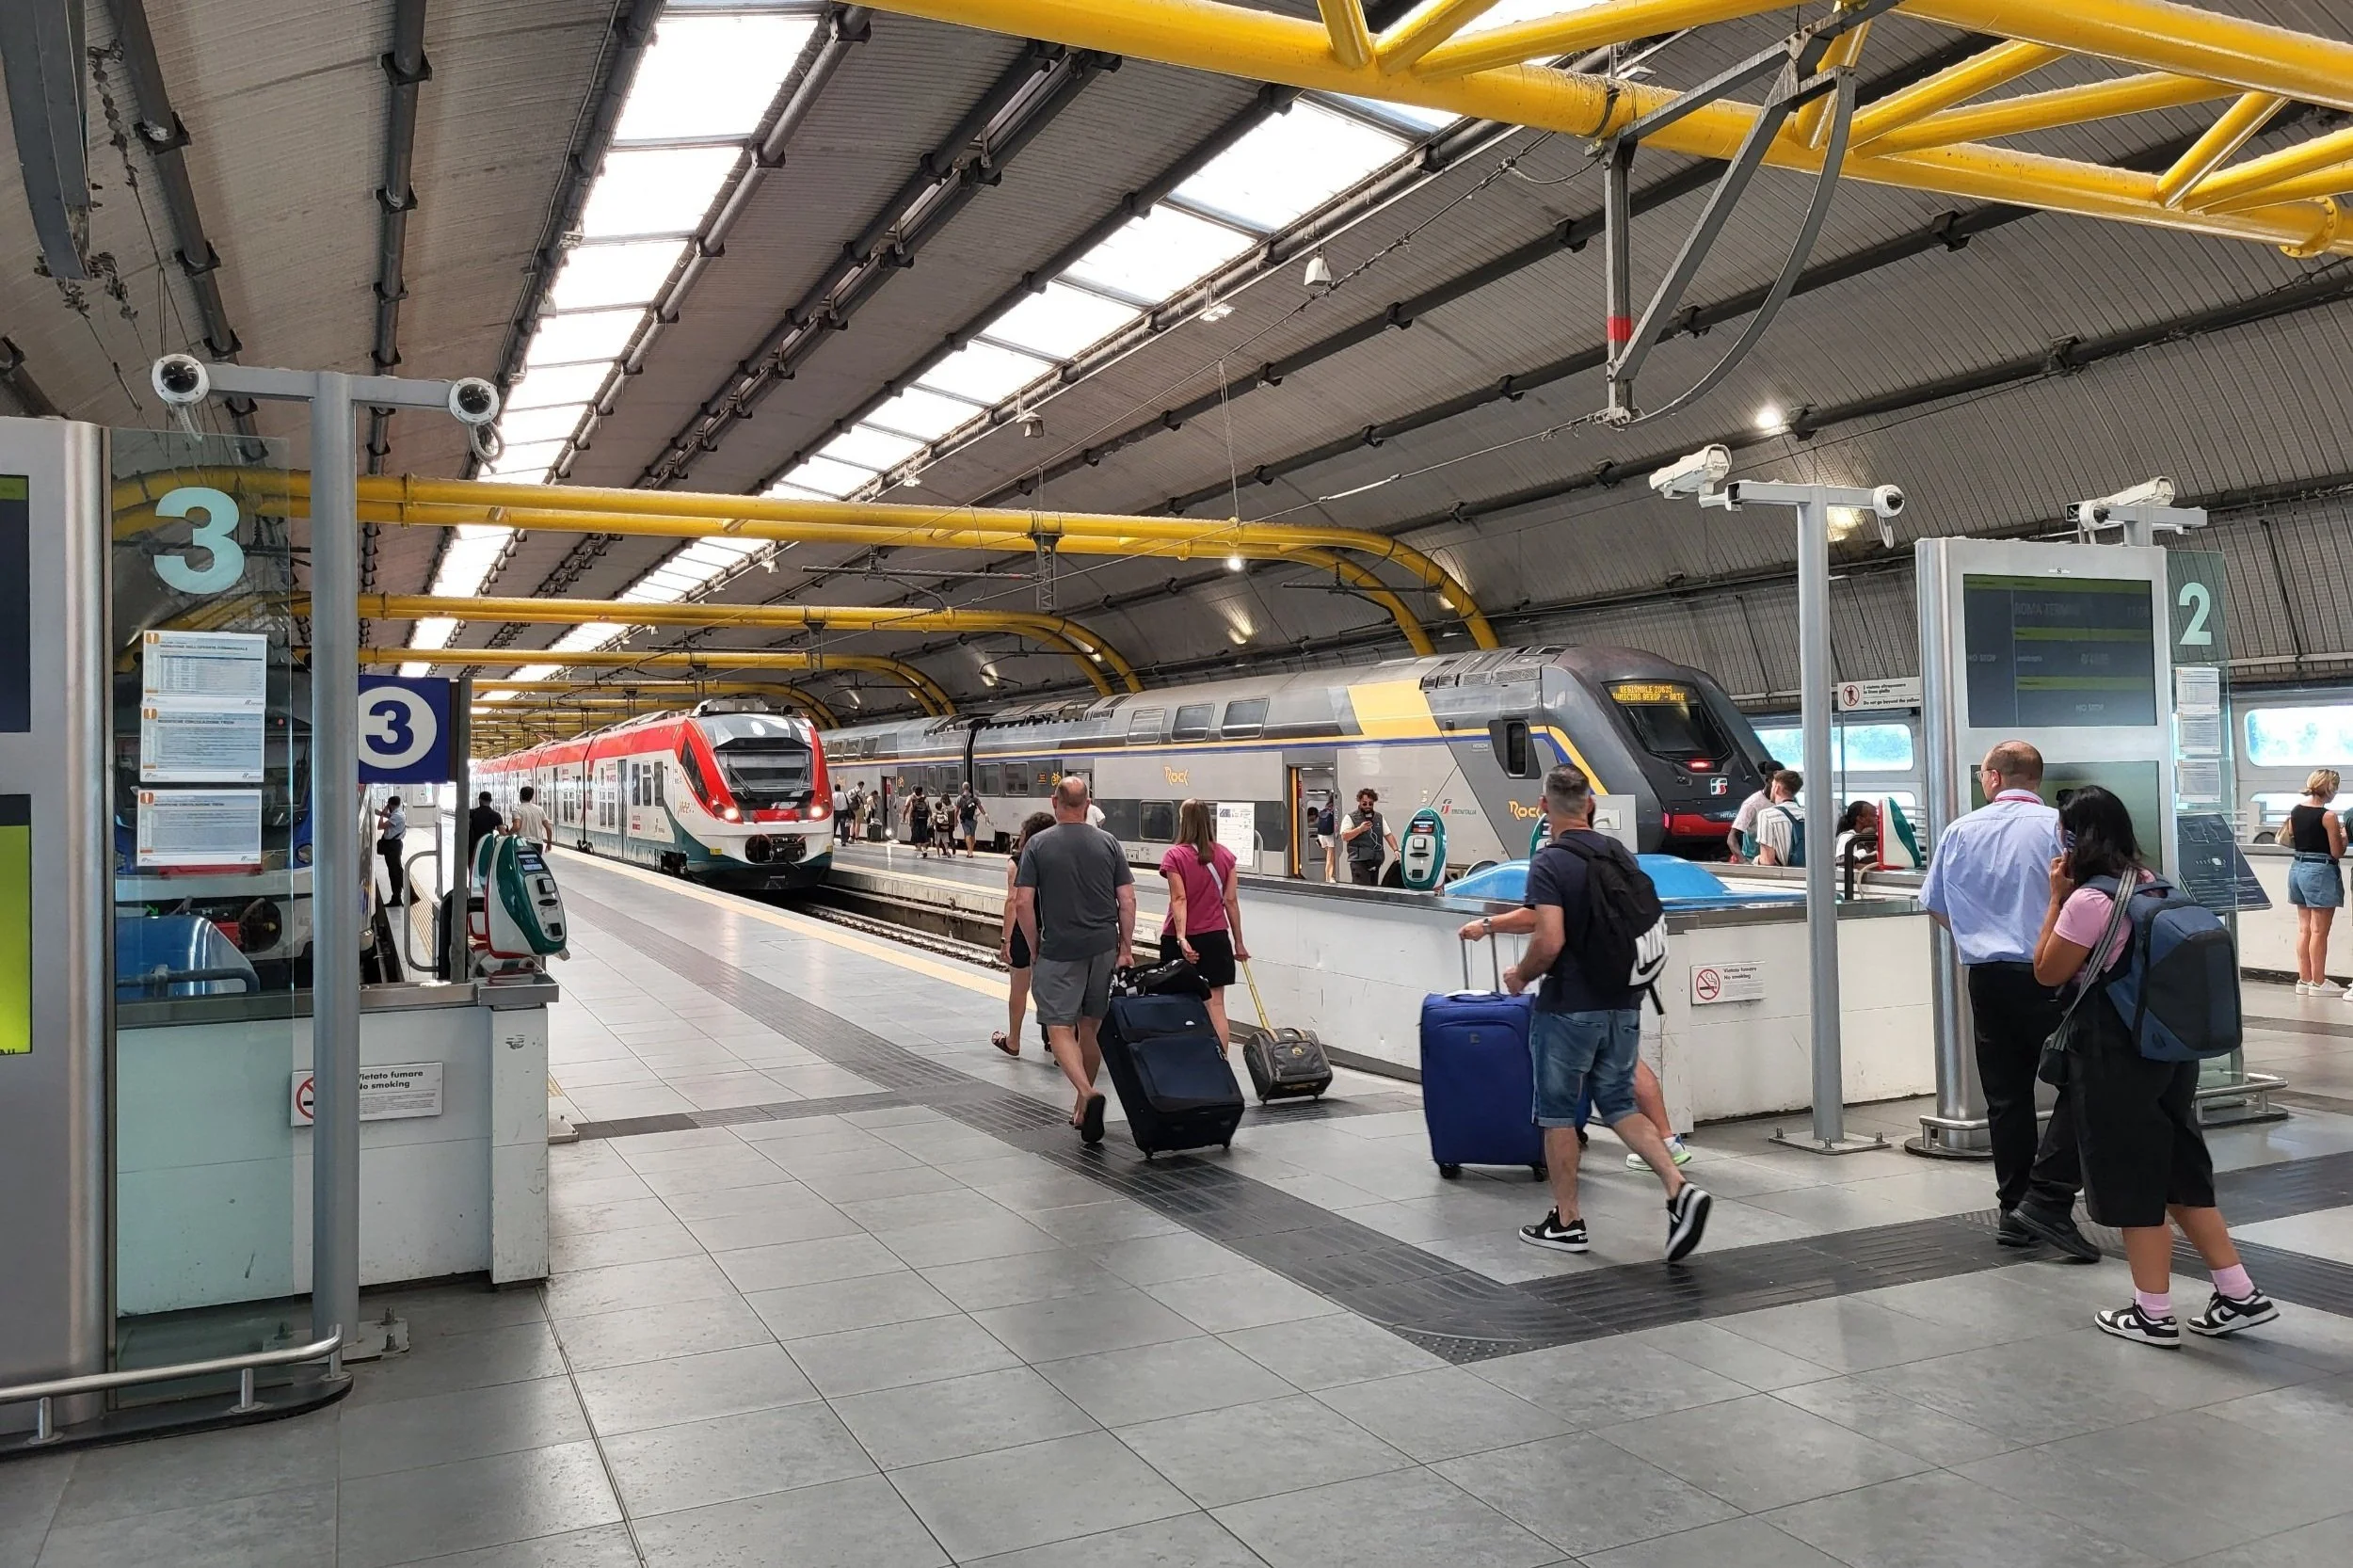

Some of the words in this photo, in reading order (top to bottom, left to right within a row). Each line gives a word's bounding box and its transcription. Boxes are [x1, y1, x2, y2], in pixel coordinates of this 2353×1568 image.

[153, 487, 245, 595] 3
[2179, 582, 2212, 646] 2
[365, 699, 414, 756] 3
[371, 1080, 410, 1089] smoking
[391, 1070, 424, 1079] fumare
